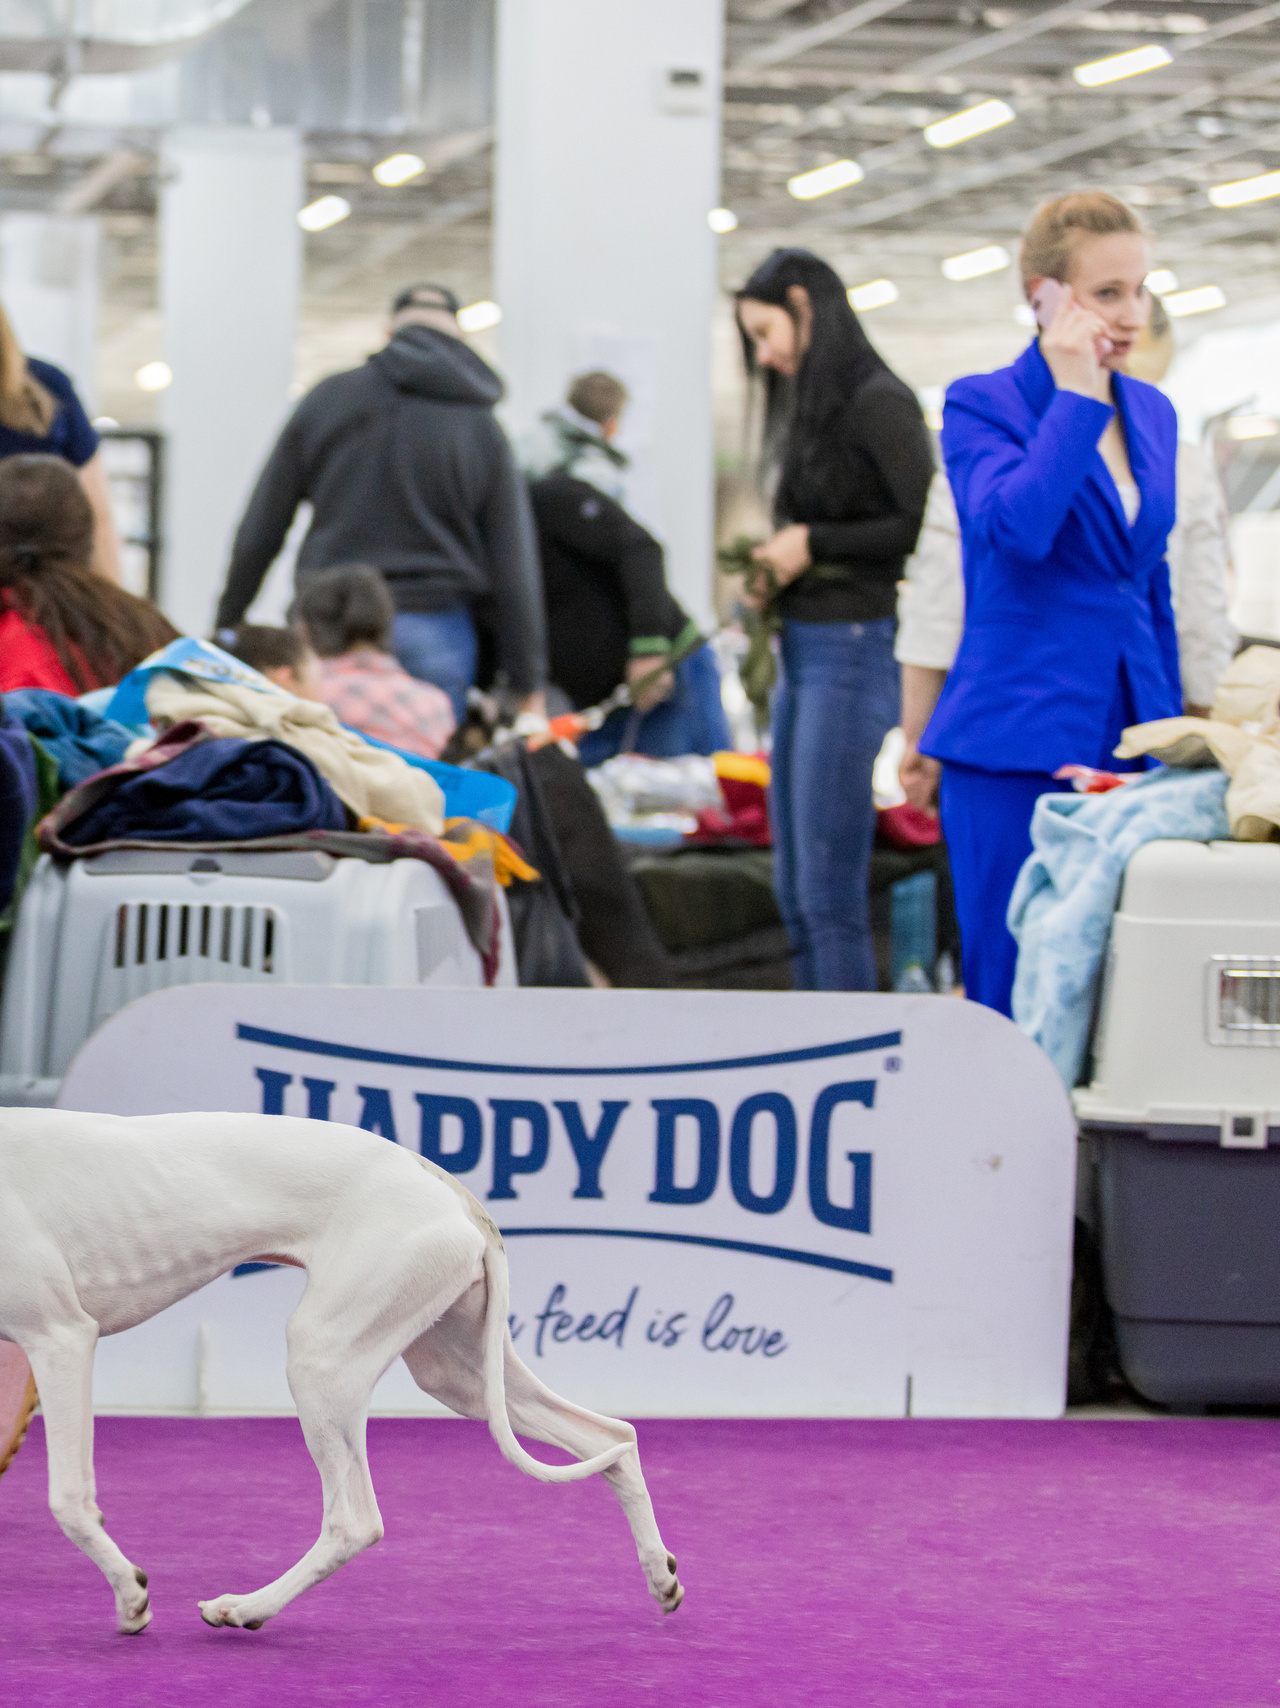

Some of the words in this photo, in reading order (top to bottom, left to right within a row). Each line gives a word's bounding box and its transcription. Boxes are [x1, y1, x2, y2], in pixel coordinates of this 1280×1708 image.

[647, 1079, 878, 1235] DOG
[534, 1284, 639, 1357] feed
[647, 1309, 687, 1347] is
[702, 1293, 786, 1357] love
